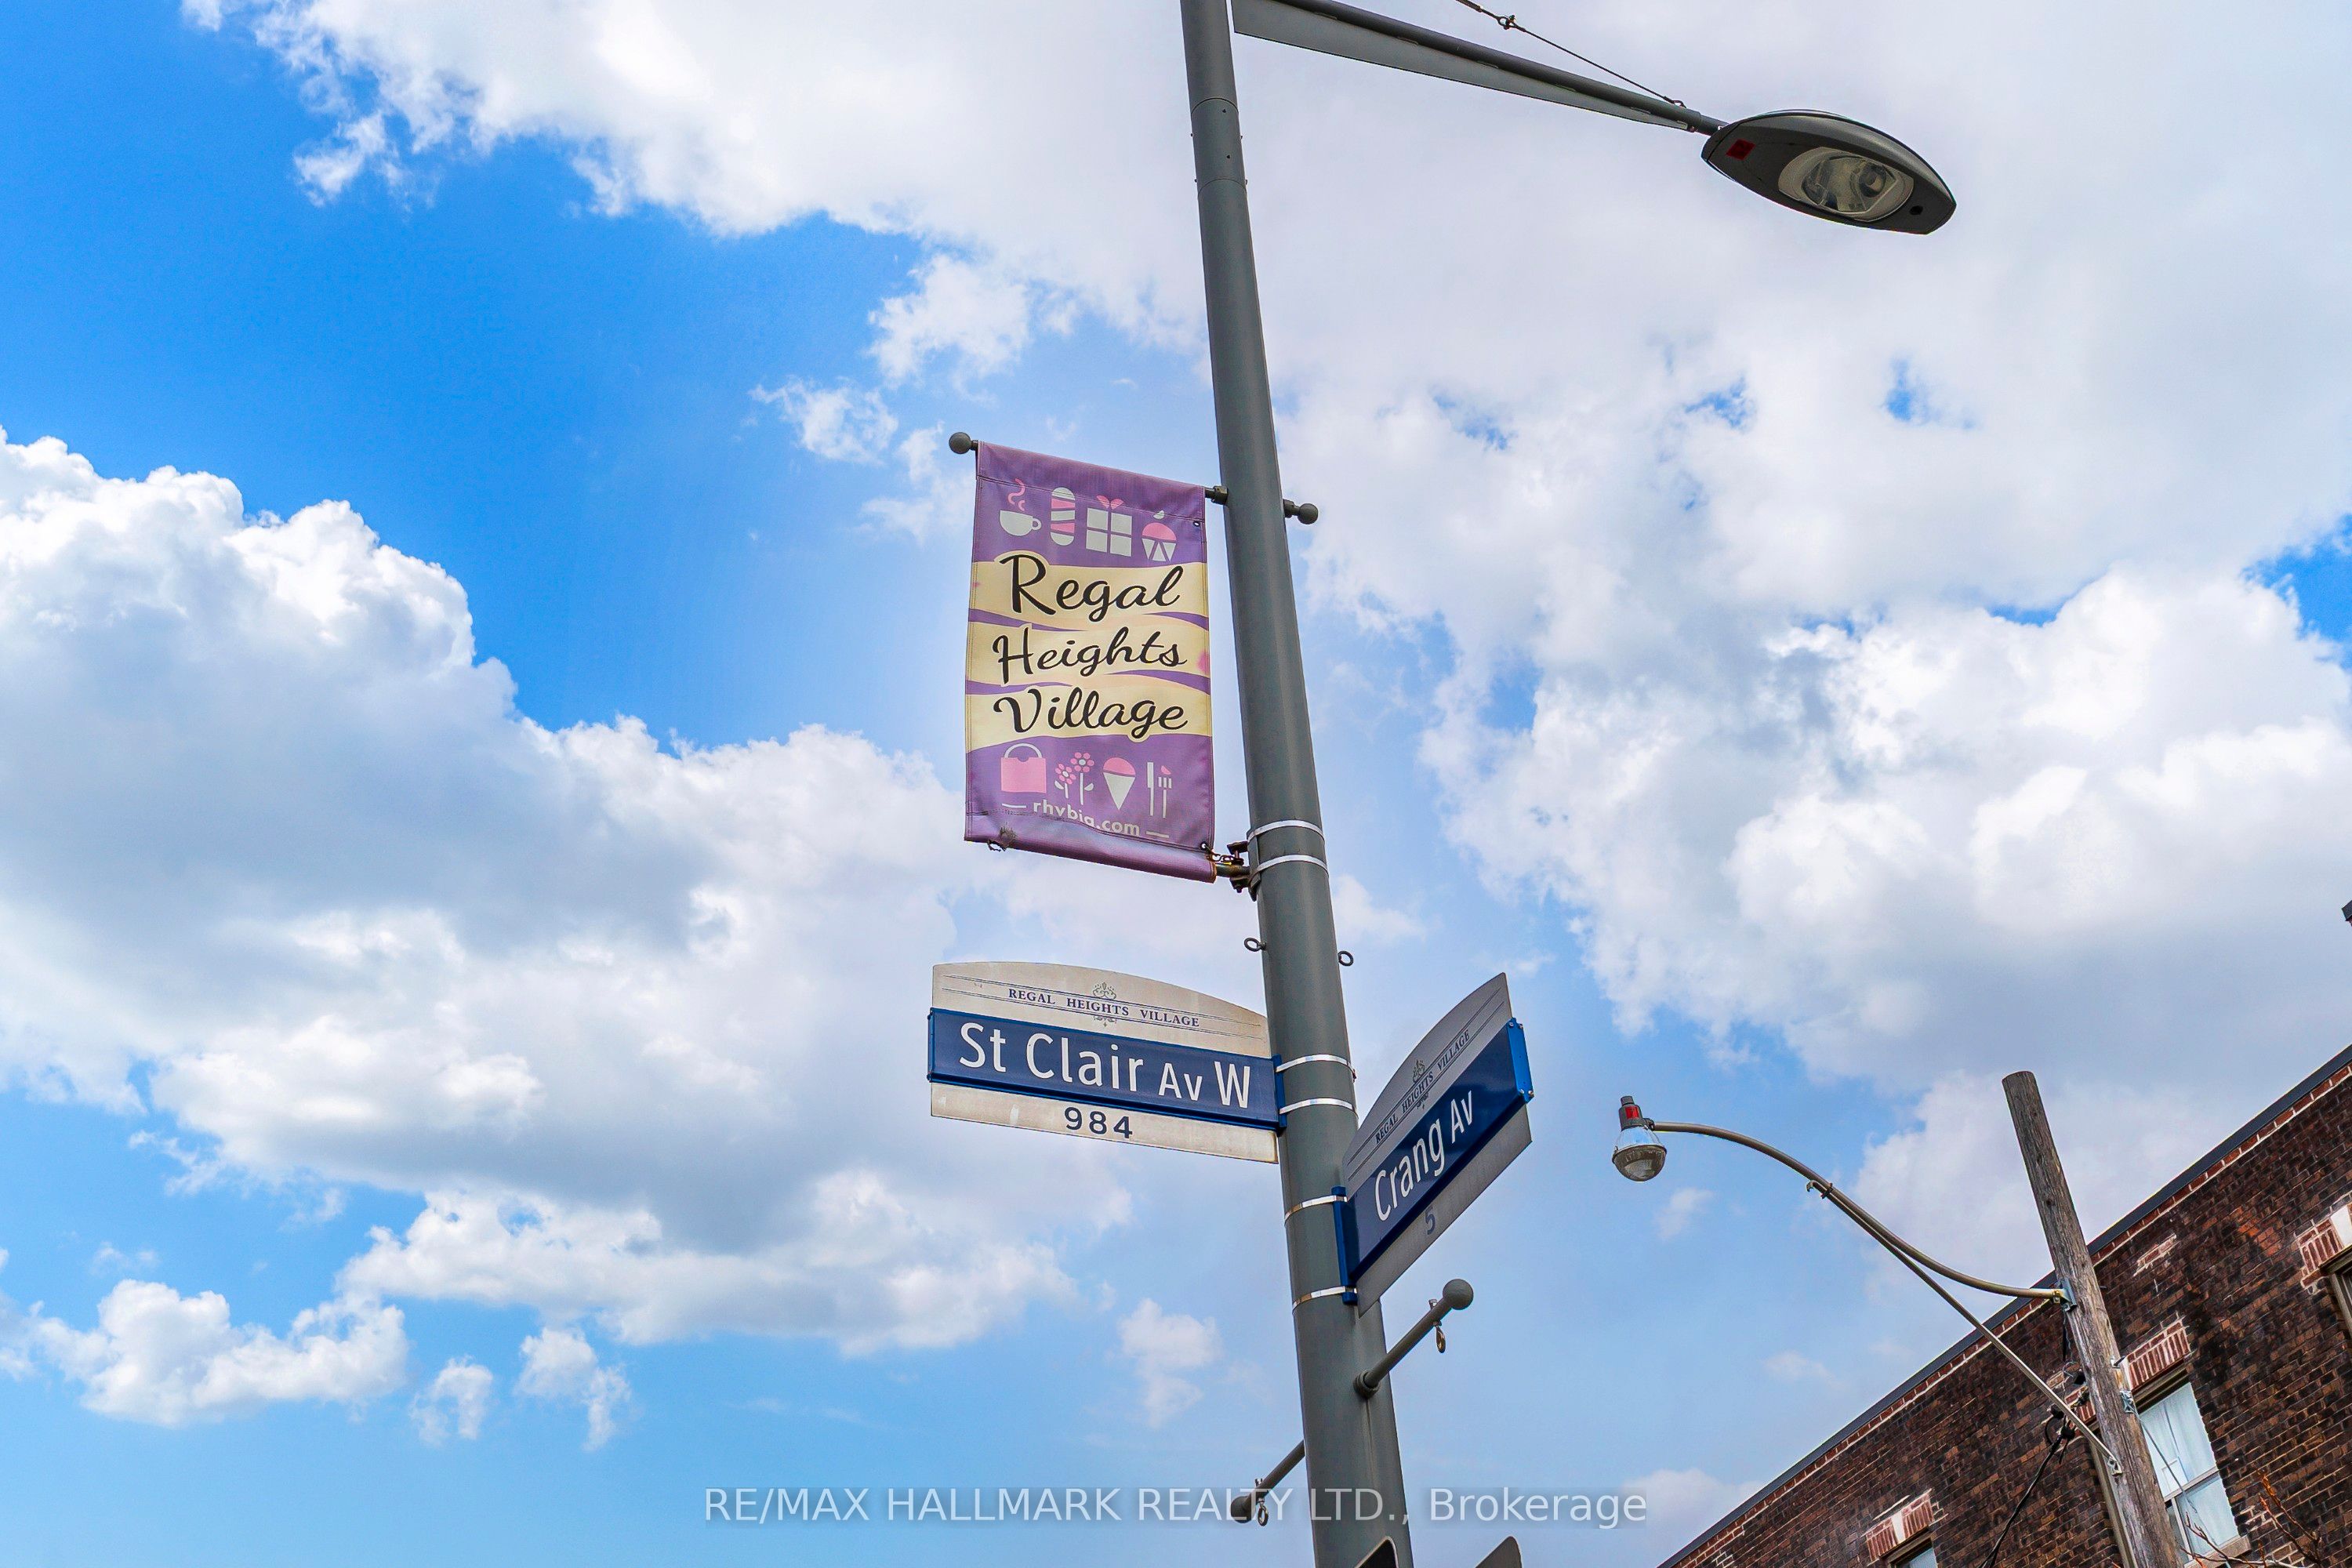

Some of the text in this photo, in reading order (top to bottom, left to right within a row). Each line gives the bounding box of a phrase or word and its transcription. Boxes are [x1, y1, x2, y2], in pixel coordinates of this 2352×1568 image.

[999, 554, 1184, 622] Regal
[992, 626, 1188, 684] Heights
[993, 687, 1189, 739] Village
[1033, 799, 1141, 837] rhvbia.com
[1008, 988, 1200, 1028] REGAL HEIGHTS VILLAGE
[959, 1022, 1251, 1109] St Clair Av W
[1375, 1029, 1471, 1145] REGAL HEIGHTS VILLAGE
[1063, 1106, 1134, 1139] 984
[1374, 1090, 1475, 1222] Crang Av
[1425, 1205, 1436, 1236] 5
